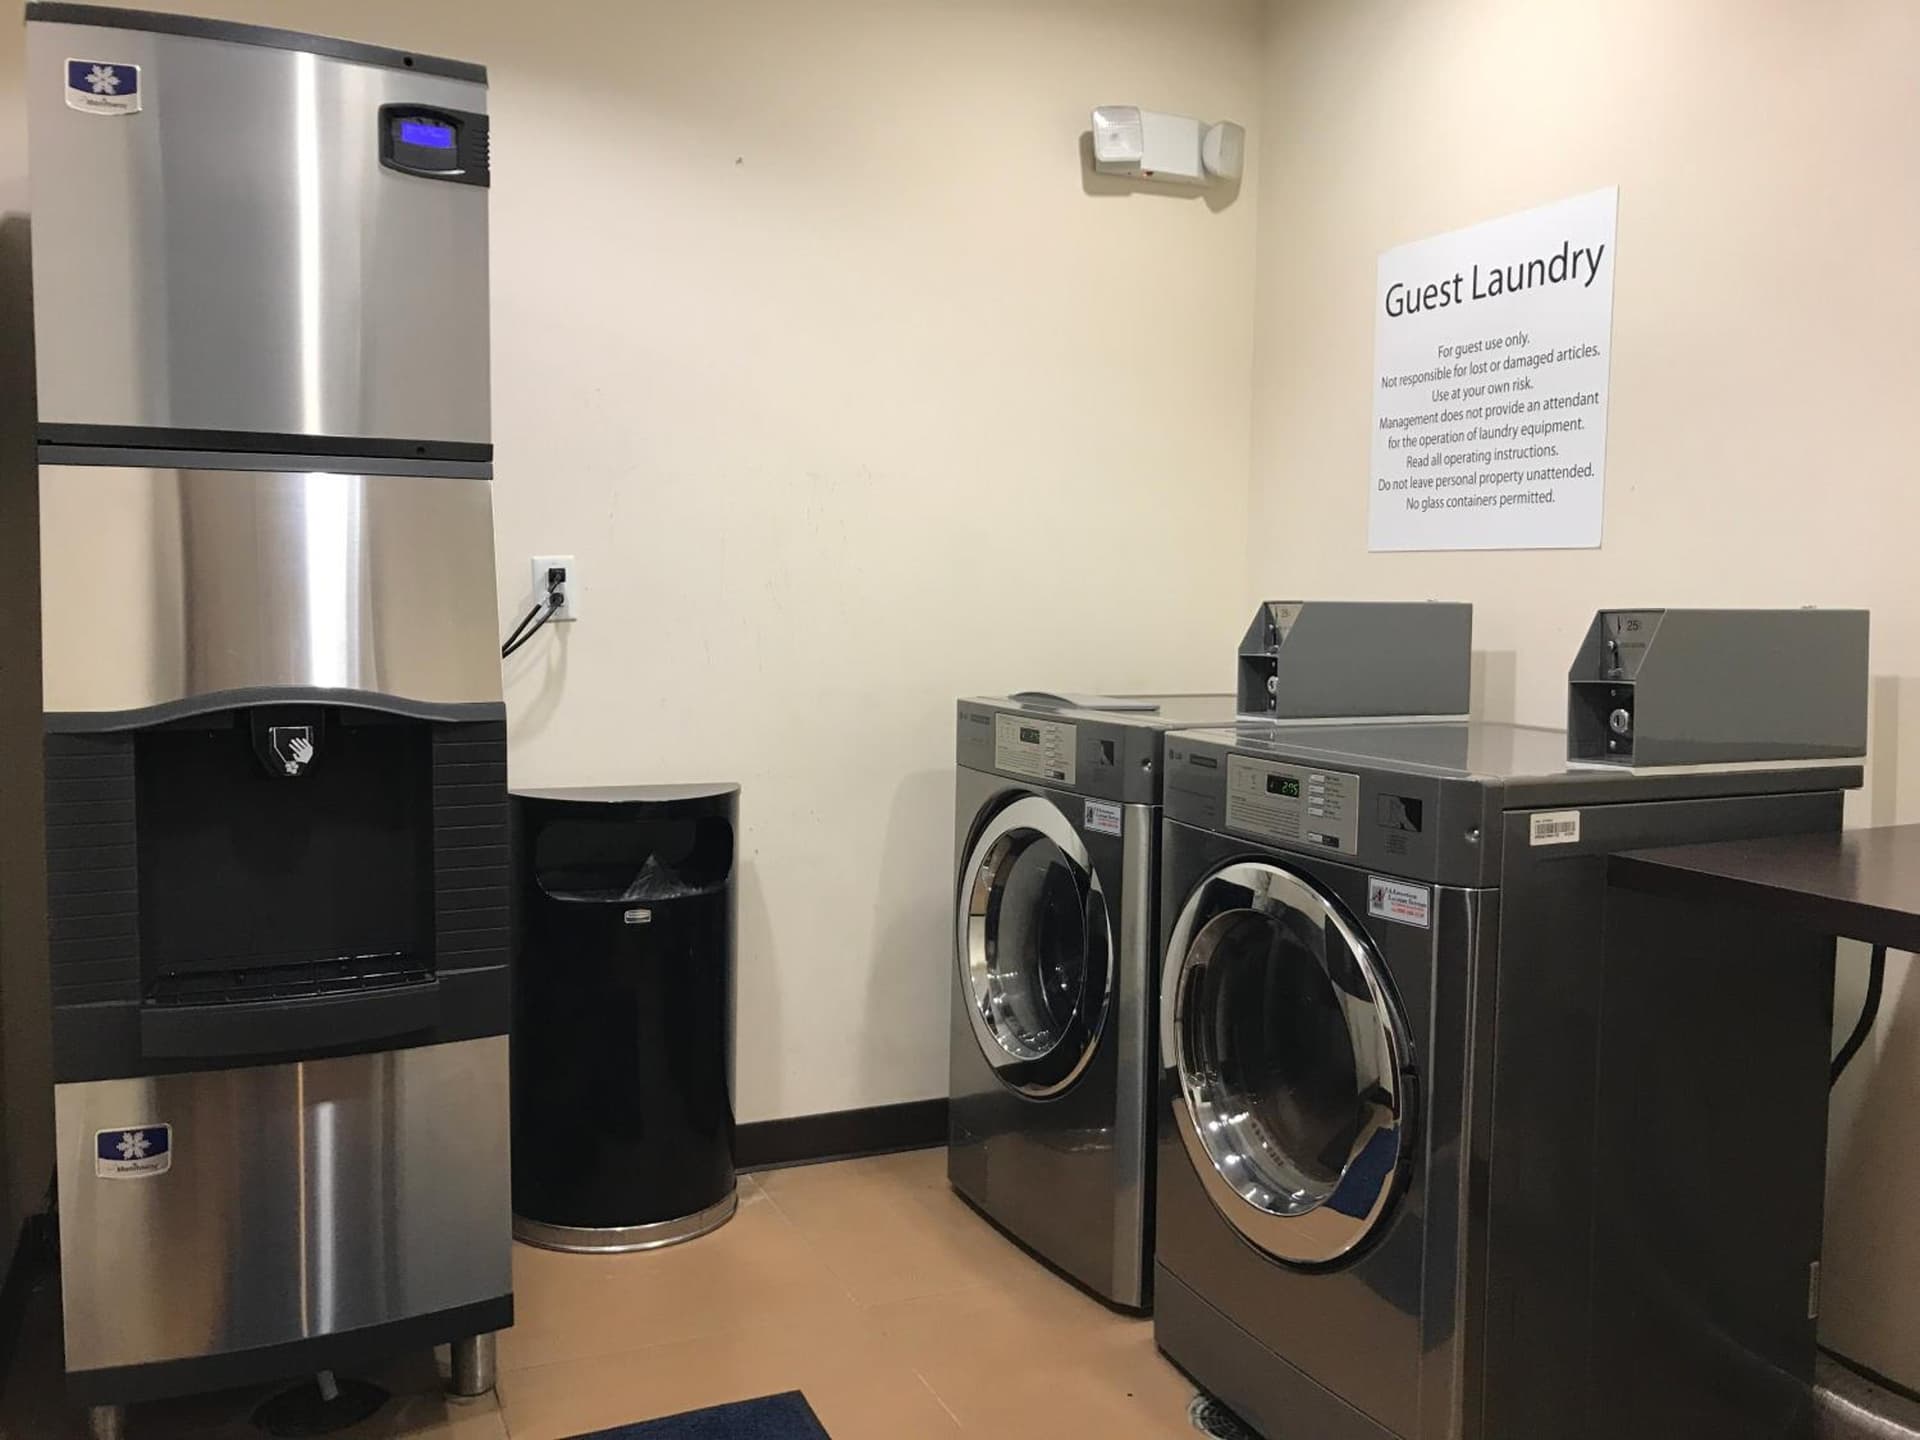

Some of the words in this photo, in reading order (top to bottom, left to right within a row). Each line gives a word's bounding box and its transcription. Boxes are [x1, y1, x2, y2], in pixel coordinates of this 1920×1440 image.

[1385, 273, 1463, 318] Guest
[1472, 241, 1605, 300] Laundry
[1437, 344, 1453, 359] For
[1455, 339, 1483, 359] guest
[1485, 338, 1503, 351] use
[1504, 330, 1530, 348] only.
[1381, 376, 1397, 388] Not
[1399, 365, 1452, 387] responsible
[1453, 363, 1467, 377] for
[1469, 361, 1488, 375] lost
[1489, 360, 1501, 372] or
[1503, 348, 1554, 369] damaged
[1556, 343, 1600, 362] articles.
[1432, 389, 1449, 402] Use
[1451, 388, 1461, 400] at
[1462, 385, 1485, 401] your
[1488, 381, 1510, 394] own
[1512, 376, 1534, 391] risk.
[1379, 411, 1438, 430] Management
[1441, 408, 1464, 422] does
[1466, 406, 1483, 419] not
[1485, 399, 1525, 420] provide
[1527, 400, 1540, 413] an
[1543, 391, 1599, 410] attendant
[1388, 435, 1400, 449] for
[1402, 434, 1417, 448] the
[1419, 430, 1464, 448] operation
[1466, 426, 1477, 441] of
[1479, 423, 1519, 440] laundry
[1521, 417, 1584, 437] equipment.
[1406, 453, 1429, 468] Read
[1431, 452, 1442, 466] all
[1444, 449, 1491, 467] operating
[1494, 444, 1559, 460] instructions.
[1378, 478, 1391, 491] Do
[1392, 478, 1408, 490] not
[1410, 475, 1434, 489] leave
[1435, 471, 1477, 490] personal
[1479, 470, 1524, 487] property
[1526, 462, 1595, 480] unattended.
[1406, 497, 1420, 510] No
[1421, 495, 1444, 512] glass
[1446, 494, 1497, 508] containers
[1499, 488, 1555, 508] permitted.
